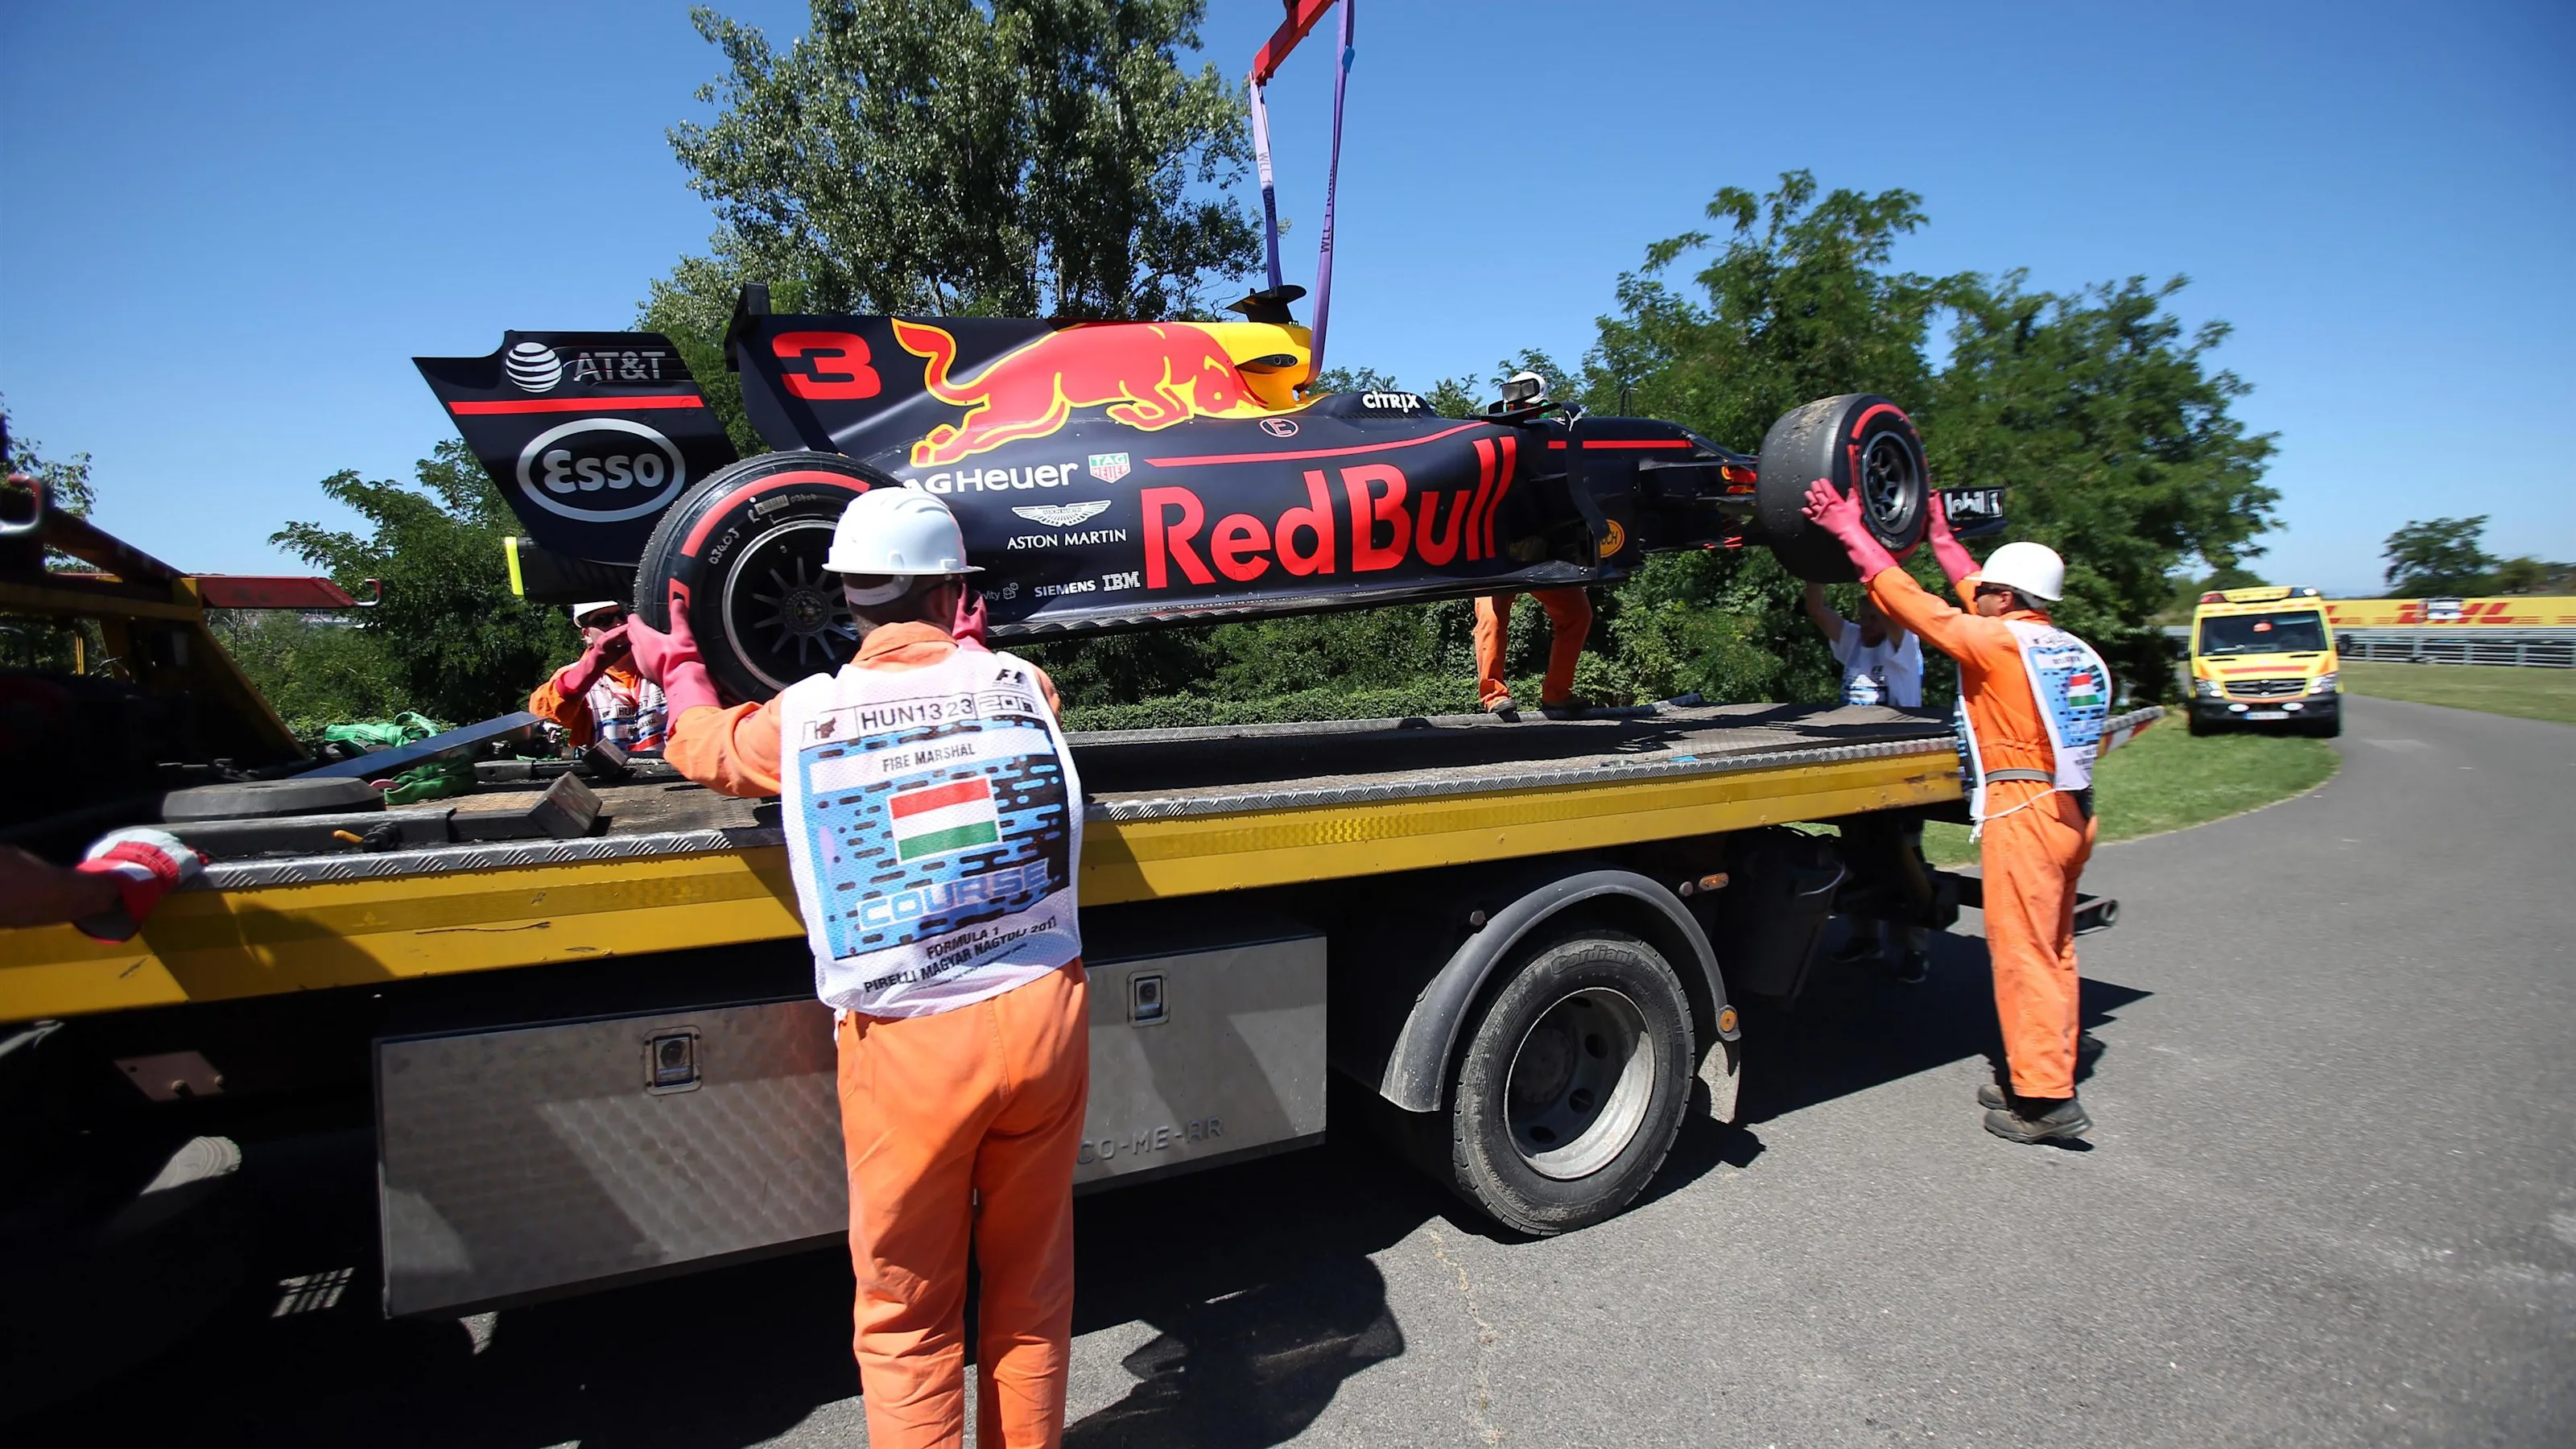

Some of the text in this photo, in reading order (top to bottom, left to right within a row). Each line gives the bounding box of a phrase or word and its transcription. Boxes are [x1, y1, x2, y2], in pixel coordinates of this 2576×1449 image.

[573, 351, 666, 382] AT&T
[772, 331, 881, 400] 3
[1265, 419, 1291, 436] E
[1090, 454, 1128, 466] TAG
[1092, 464, 1129, 481] HEUER
[1944, 490, 1985, 521] obil
[1007, 529, 1127, 550] ASTON MARTIN
[1034, 580, 1096, 597] SIEMENS
[1102, 571, 1141, 592] IBM
[882, 743, 976, 772] FIRE MARSHAL
[859, 859, 1049, 930] COURSE
[926, 927, 999, 960] FORMULA 1
[864, 969, 917, 993] PIRELLI
[920, 947, 972, 980] MAGYAR
[1550, 944, 1639, 976] Cordiant
